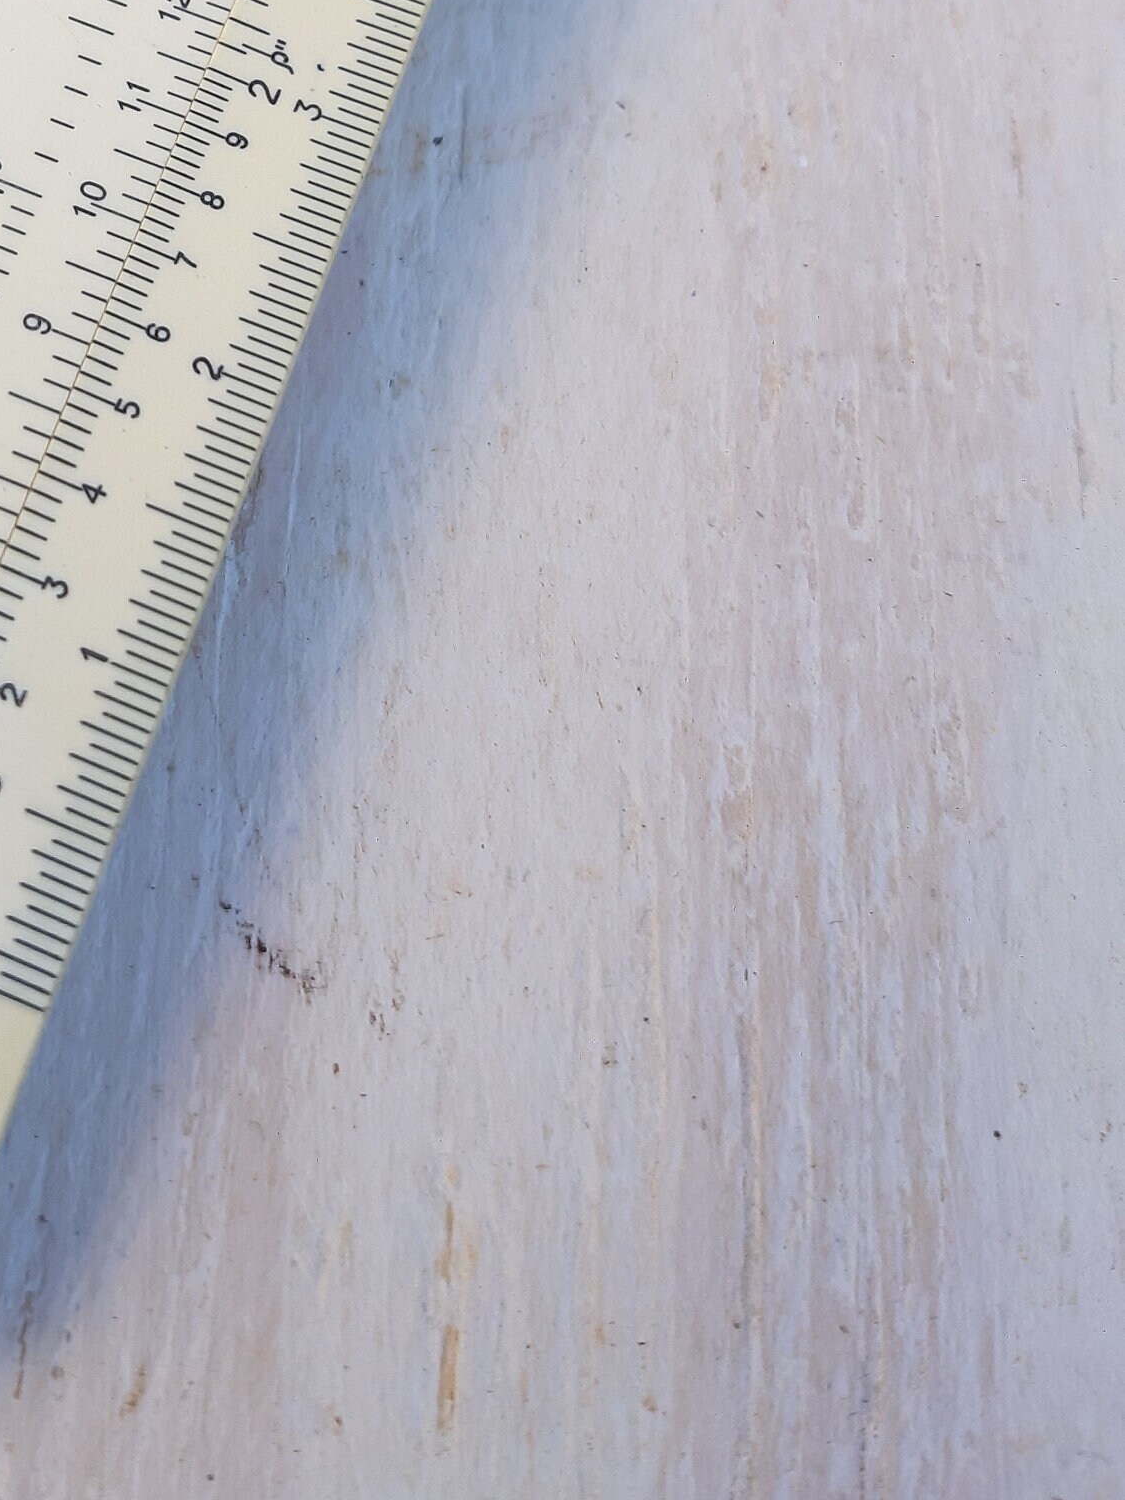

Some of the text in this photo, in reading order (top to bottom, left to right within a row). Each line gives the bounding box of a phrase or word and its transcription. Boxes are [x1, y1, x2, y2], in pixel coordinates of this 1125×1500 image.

[117, 81, 150, 113] 11
[248, 79, 282, 105] 2
[294, 99, 323, 121] 3
[225, 131, 249, 149] 9
[73, 181, 107, 217] 10
[199, 190, 225, 210] 8
[174, 251, 197, 269] 7
[23, 313, 52, 335] 9
[145, 323, 171, 342] 6
[192, 356, 224, 381] 2
[114, 398, 140, 419] 5
[81, 482, 107, 504] 4
[41, 576, 68, 599] 3
[80, 646, 109, 663] 1
